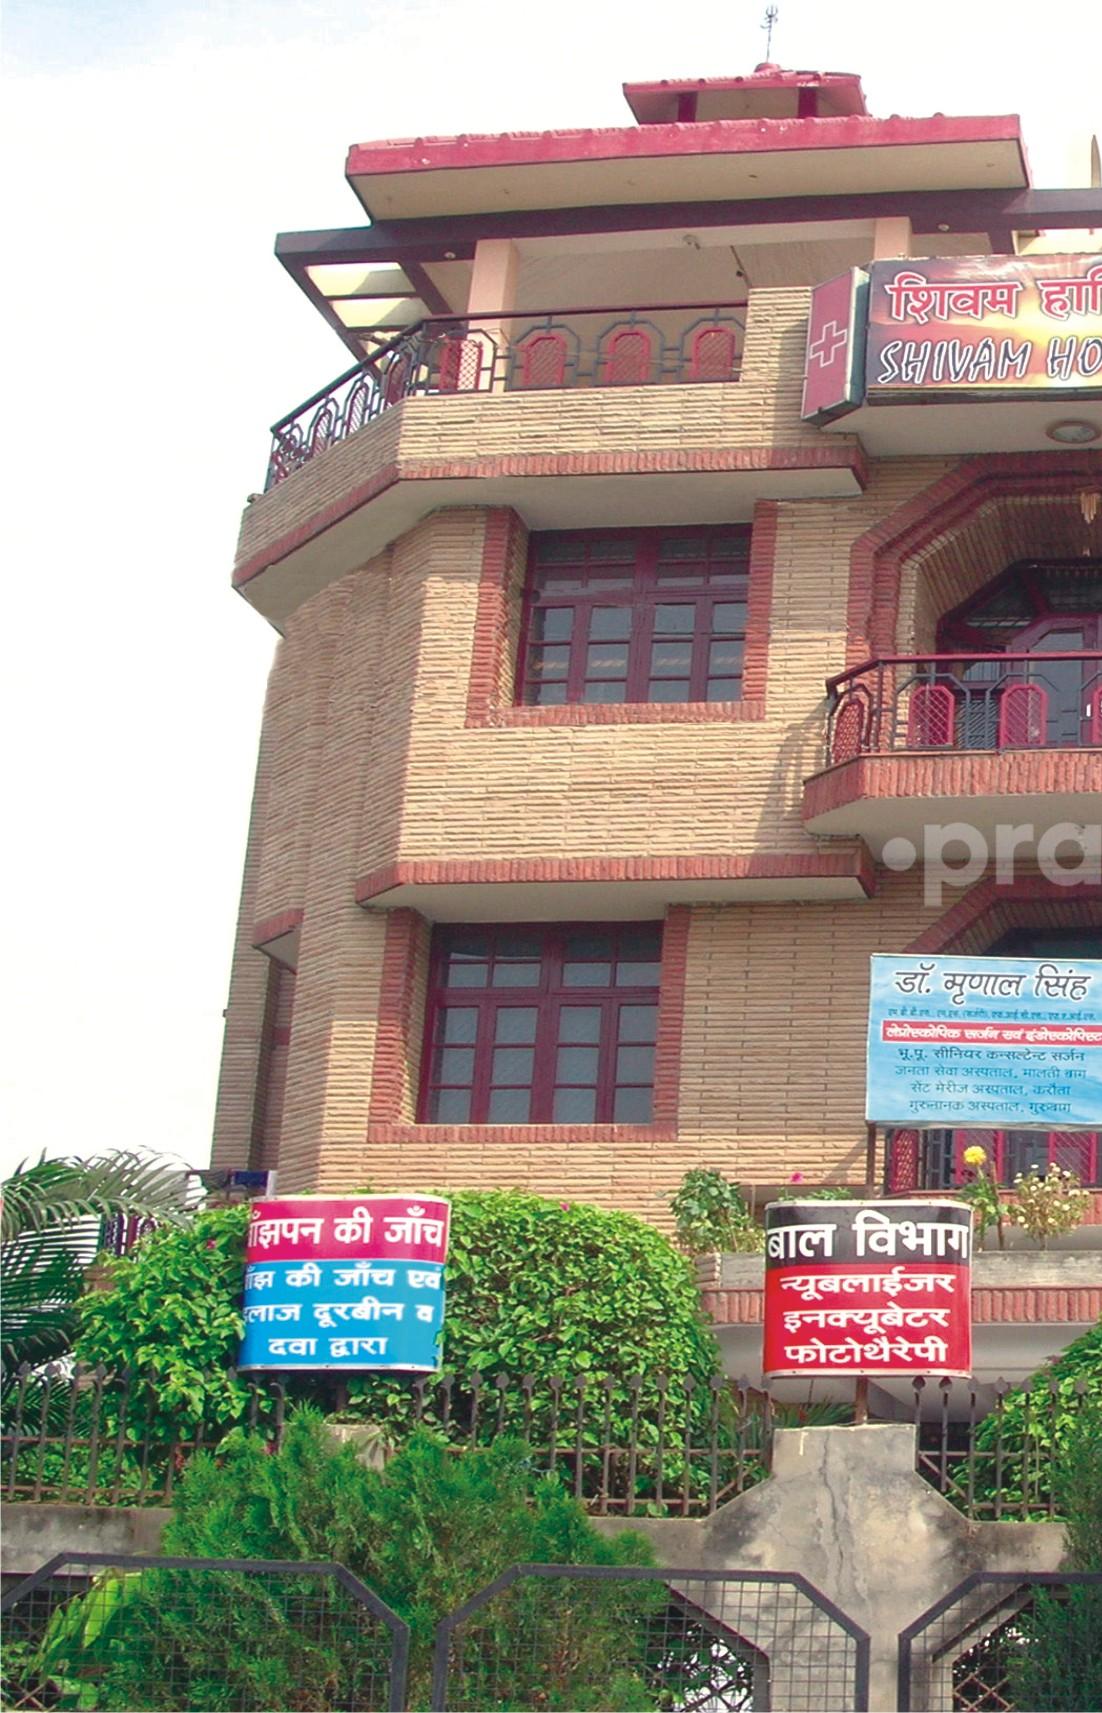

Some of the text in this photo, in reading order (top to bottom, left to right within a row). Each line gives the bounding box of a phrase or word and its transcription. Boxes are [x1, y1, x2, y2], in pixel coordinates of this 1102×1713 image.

[885, 270, 1021, 324] शिवम
[877, 337, 1031, 384] SHIVAM
[895, 962, 1092, 1004] डॉ. मृणाल सिंह
[895, 1066, 929, 1076] जनता
[934, 1064, 958, 1076] सेवा
[933, 1046, 981, 1059] सीनियर
[1051, 1048, 1085, 1061] सर्जन
[334, 1206, 373, 1244] की
[383, 1206, 444, 1247] जाँच
[767, 1209, 969, 1259] बाल विभाग
[285, 1262, 322, 1287] की
[333, 1261, 396, 1286] जाँच
[407, 1266, 443, 1290] एवं
[780, 1266, 957, 1300] न्यूबलाईजर
[313, 1296, 405, 1327] दूरबीन
[415, 1304, 435, 1322] व
[783, 1302, 951, 1335] इनक्यूबेटर
[268, 1337, 388, 1358] दवा द्वारा
[784, 1335, 949, 1364] फोटोथैरेपी
